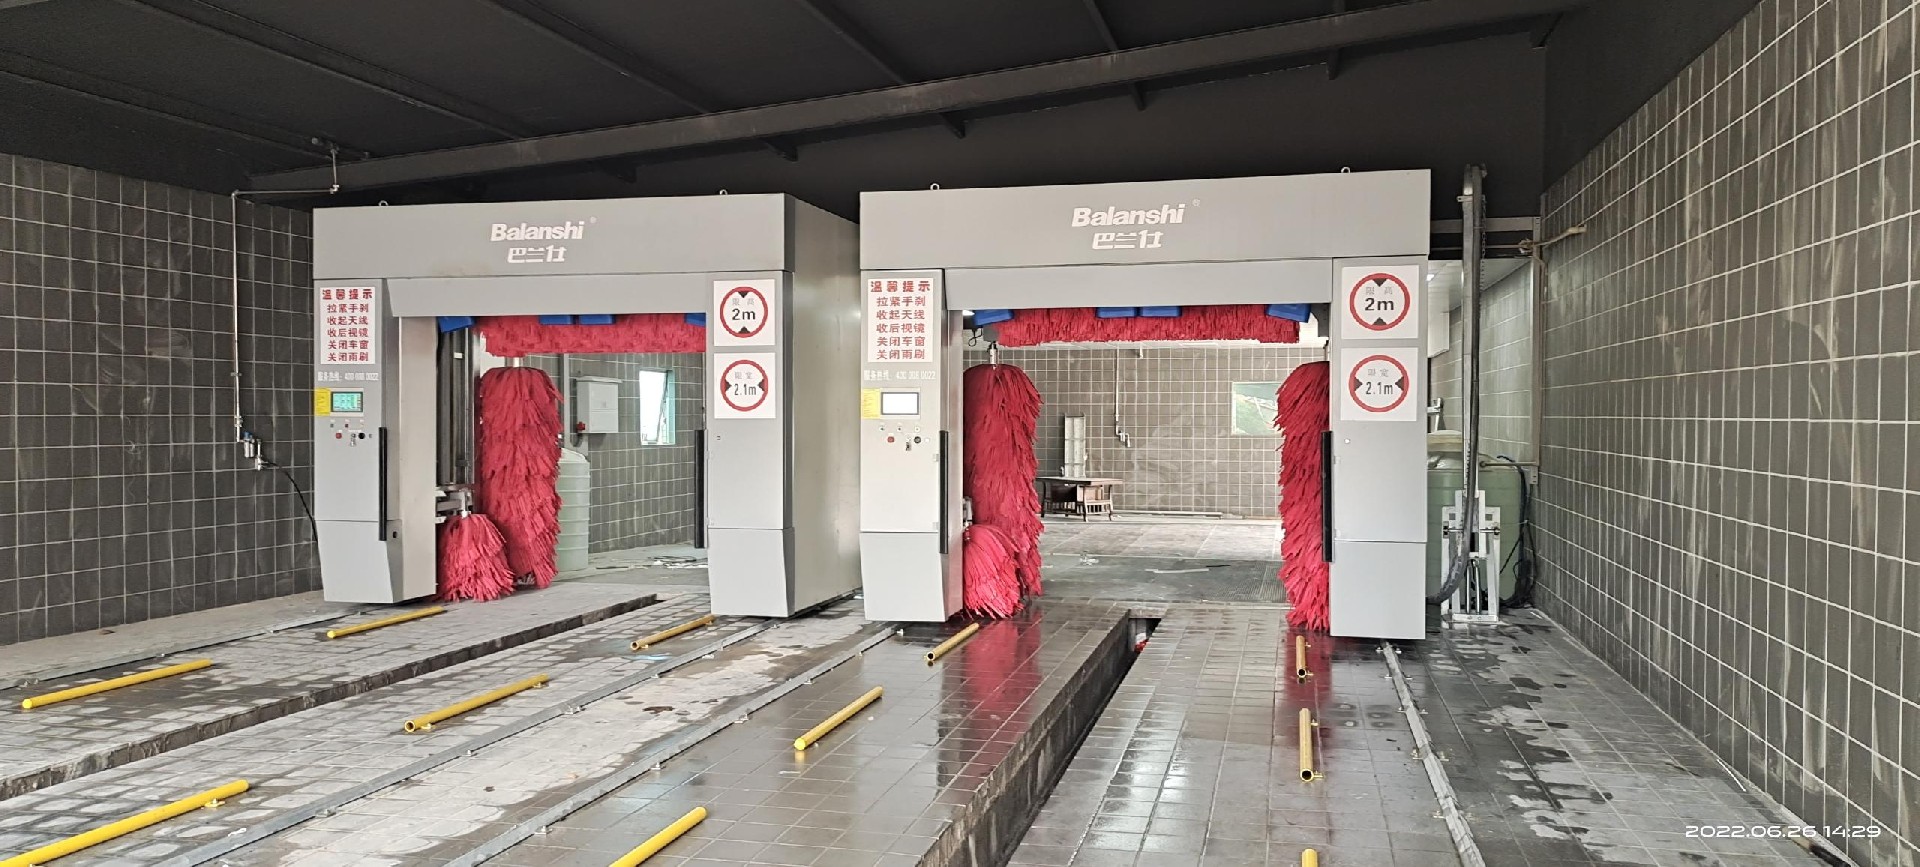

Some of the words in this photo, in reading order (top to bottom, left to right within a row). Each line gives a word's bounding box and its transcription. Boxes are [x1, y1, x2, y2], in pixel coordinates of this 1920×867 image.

[1072, 203, 1185, 227] Balanshi
[490, 221, 585, 241] Balanshi
[1092, 229, 1163, 250] 巴兰仕
[507, 244, 567, 263] 巴兰仕
[870, 281, 930, 293] 温馨提示
[876, 296, 925, 307] 拉紧手刹
[1365, 297, 1394, 311] 2m
[732, 308, 756, 321] 2m
[876, 310, 925, 320] 收起天线
[327, 316, 369, 325] 收起天线
[327, 328, 369, 337] 收后视镜
[876, 323, 925, 334] 收后视镜
[327, 340, 369, 350] 关闭车窗
[876, 336, 925, 347] 关闭车窗
[327, 352, 369, 362] 关闭雨刷
[876, 349, 925, 360] 关闭雨刷
[734, 383, 757, 396] 2.1m
[1365, 381, 1393, 395] 2.1m
